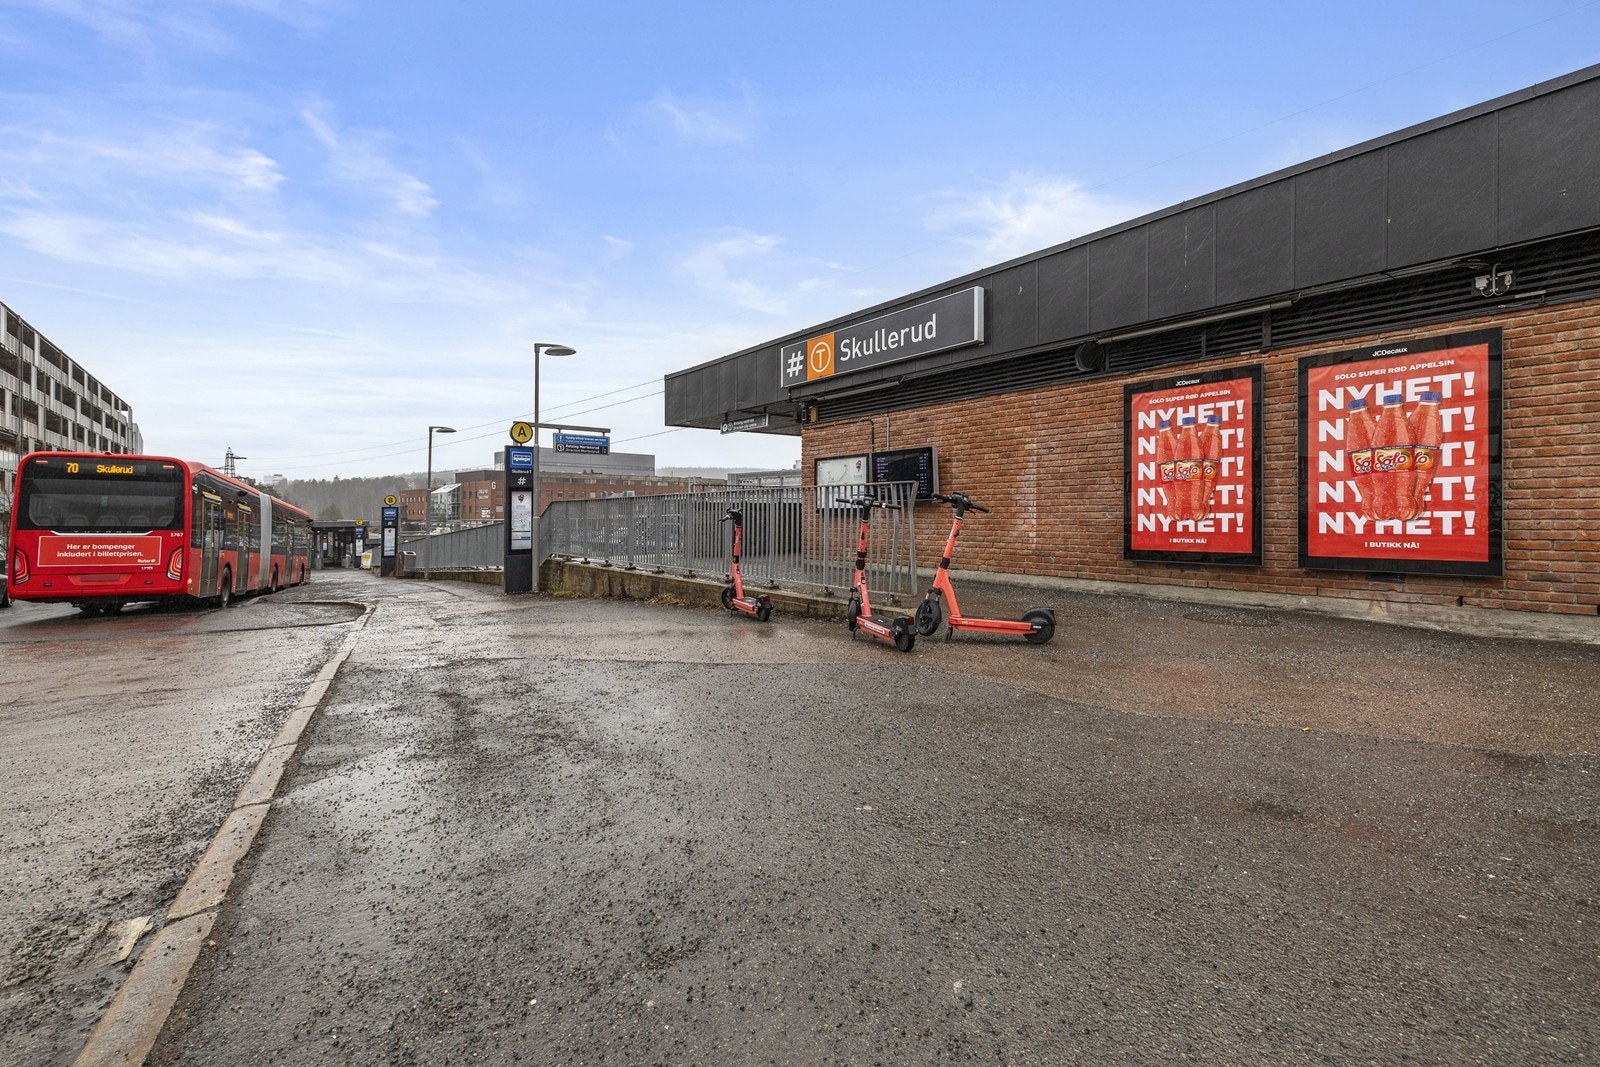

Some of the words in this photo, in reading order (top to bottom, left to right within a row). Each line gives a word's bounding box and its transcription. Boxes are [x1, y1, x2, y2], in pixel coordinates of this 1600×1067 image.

[839, 313, 937, 362] Skullerud
[1372, 347, 1408, 357] JCDecaux
[1334, 372, 1357, 381] SOLO
[1358, 368, 1387, 378] SUPER
[1388, 366, 1408, 375] RØD
[1409, 359, 1455, 371] APPELSIN
[1175, 379, 1200, 387] JCDecaux
[1318, 371, 1475, 412] NYHET!
[1165, 395, 1185, 403] SUPER
[1200, 389, 1231, 399] APPELSIN
[1138, 400, 1245, 430] NYHET!
[1318, 406, 1475, 442] NT!
[517, 426, 527, 437] A
[1138, 428, 1245, 456] NT!
[1318, 441, 1475, 473] NT!
[1377, 452, 1407, 465] Solo
[66, 462, 79, 473] 70
[96, 464, 134, 474] Skullerud
[1138, 456, 1245, 481] NT!
[491, 481, 497, 490] G
[1369, 541, 1402, 549] BUTIKK
[1403, 541, 1420, 549] NÅ!
